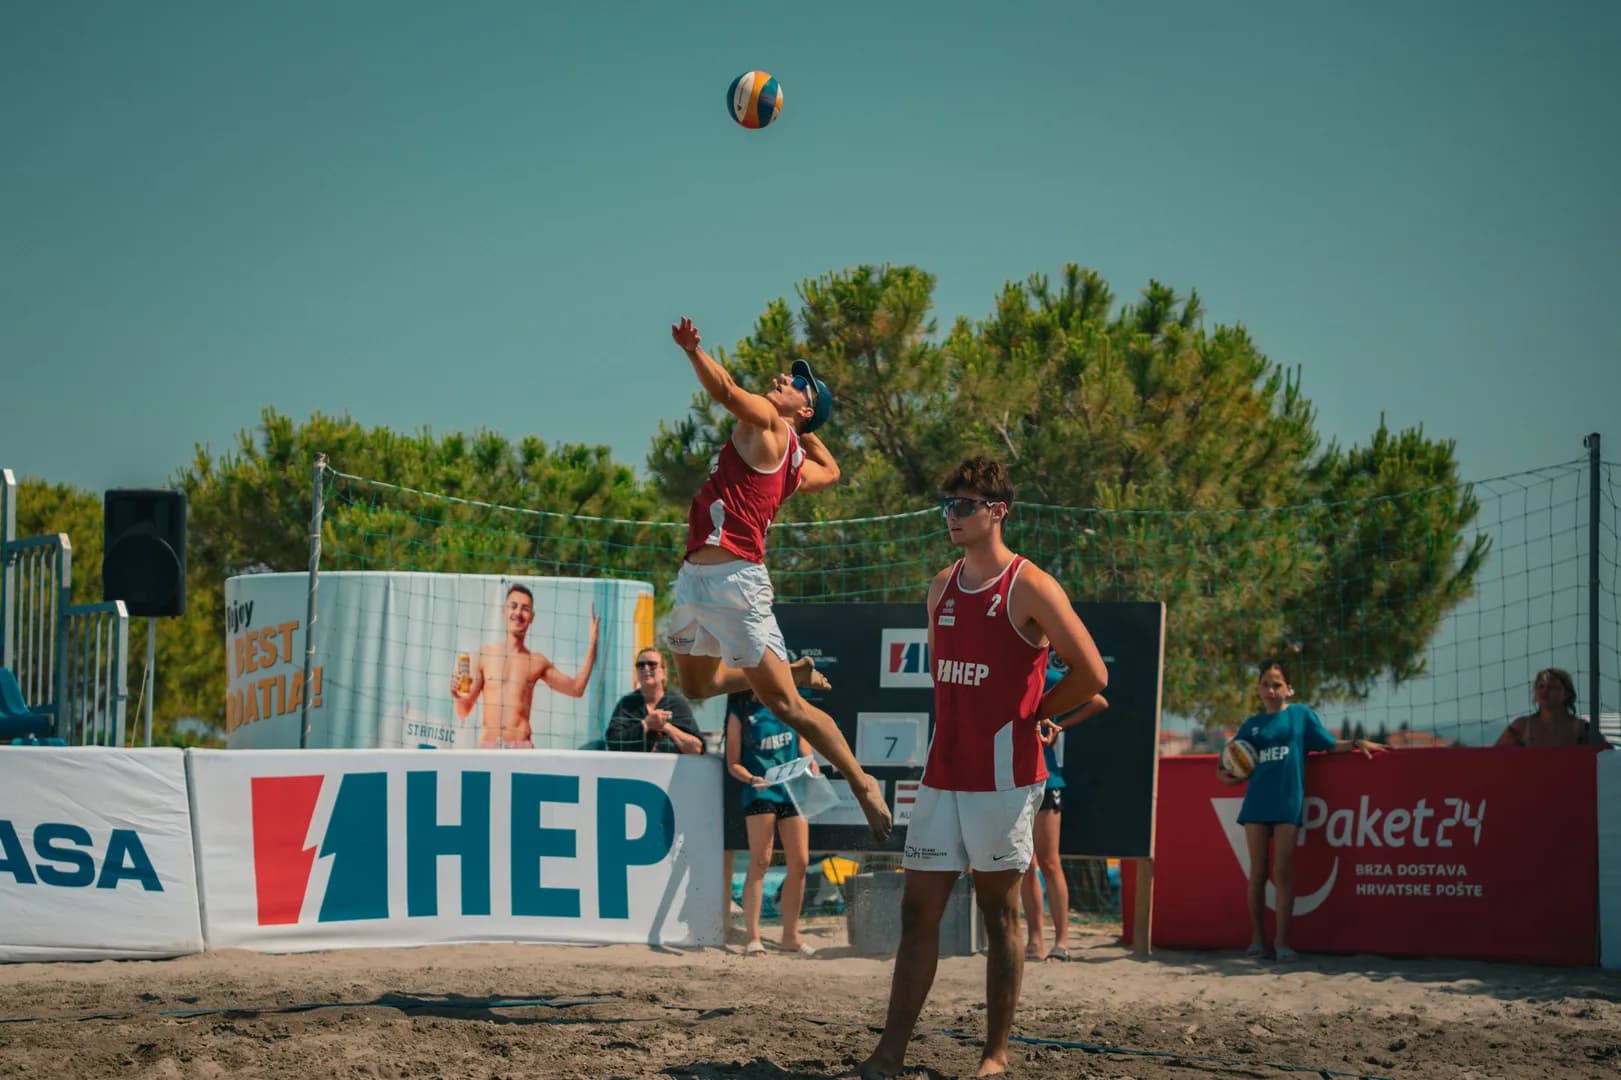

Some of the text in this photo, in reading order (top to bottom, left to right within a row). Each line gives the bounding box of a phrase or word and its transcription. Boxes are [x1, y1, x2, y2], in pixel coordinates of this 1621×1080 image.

[986, 593, 1002, 617] 2
[234, 620, 300, 678] BEST
[951, 660, 990, 687] HEP
[884, 736, 899, 759] 7
[406, 771, 676, 919] HEP
[1355, 864, 1467, 876] BRZA DOSTAVA
[1356, 881, 1483, 897] HRVATSKE POŠTE
